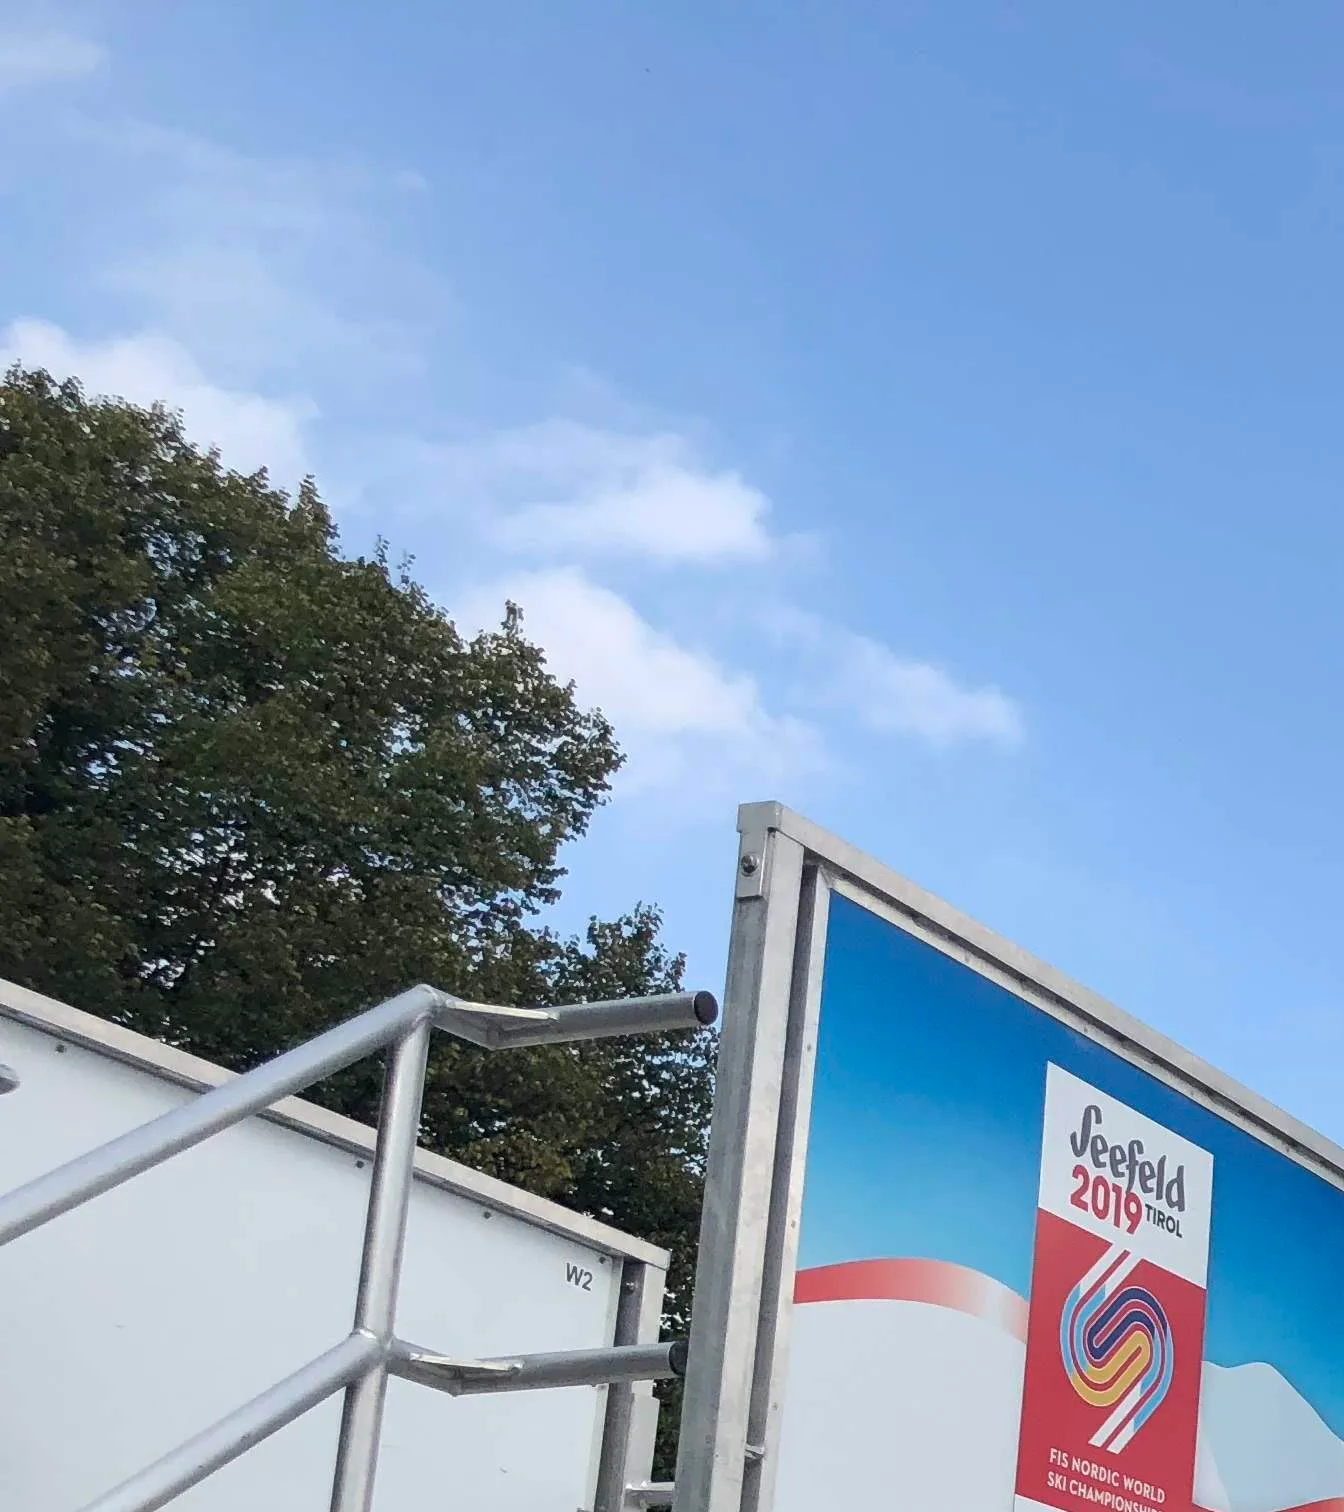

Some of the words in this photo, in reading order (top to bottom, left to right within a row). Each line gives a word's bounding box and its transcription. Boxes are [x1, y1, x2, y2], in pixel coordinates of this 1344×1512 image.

[1070, 1104, 1185, 1212] Seefeld
[1070, 1164, 1143, 1235] 2019
[1145, 1203, 1183, 1238] TIROL
[566, 1262, 593, 1291] W2
[1047, 1471, 1066, 1491] SKI
[1050, 1447, 1068, 1468] FIS
[1071, 1456, 1120, 1487] NORDIC
[1123, 1474, 1165, 1503] WORLD
